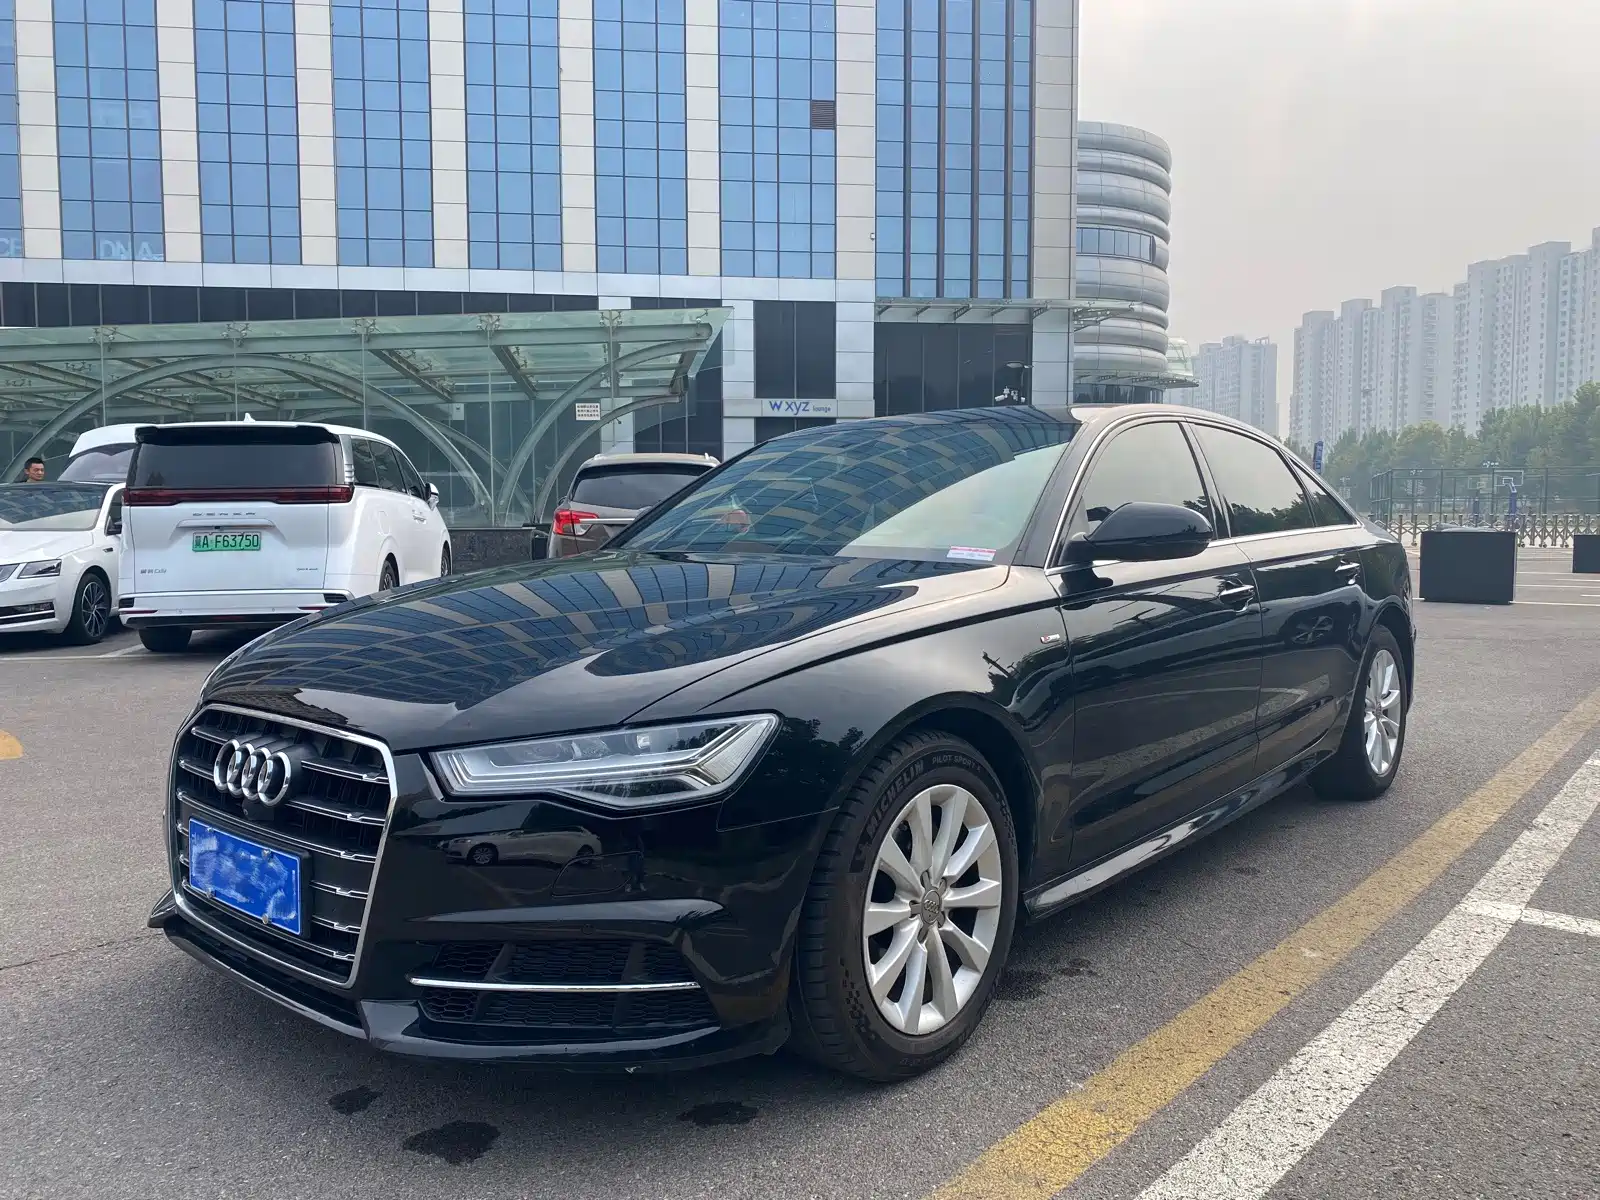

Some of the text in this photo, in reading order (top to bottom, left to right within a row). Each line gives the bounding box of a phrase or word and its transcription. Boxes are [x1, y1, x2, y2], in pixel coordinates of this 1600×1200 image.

[812, 405, 831, 414] lounge
[215, 534, 259, 549] F63750
[866, 759, 924, 839] MICHELIN
